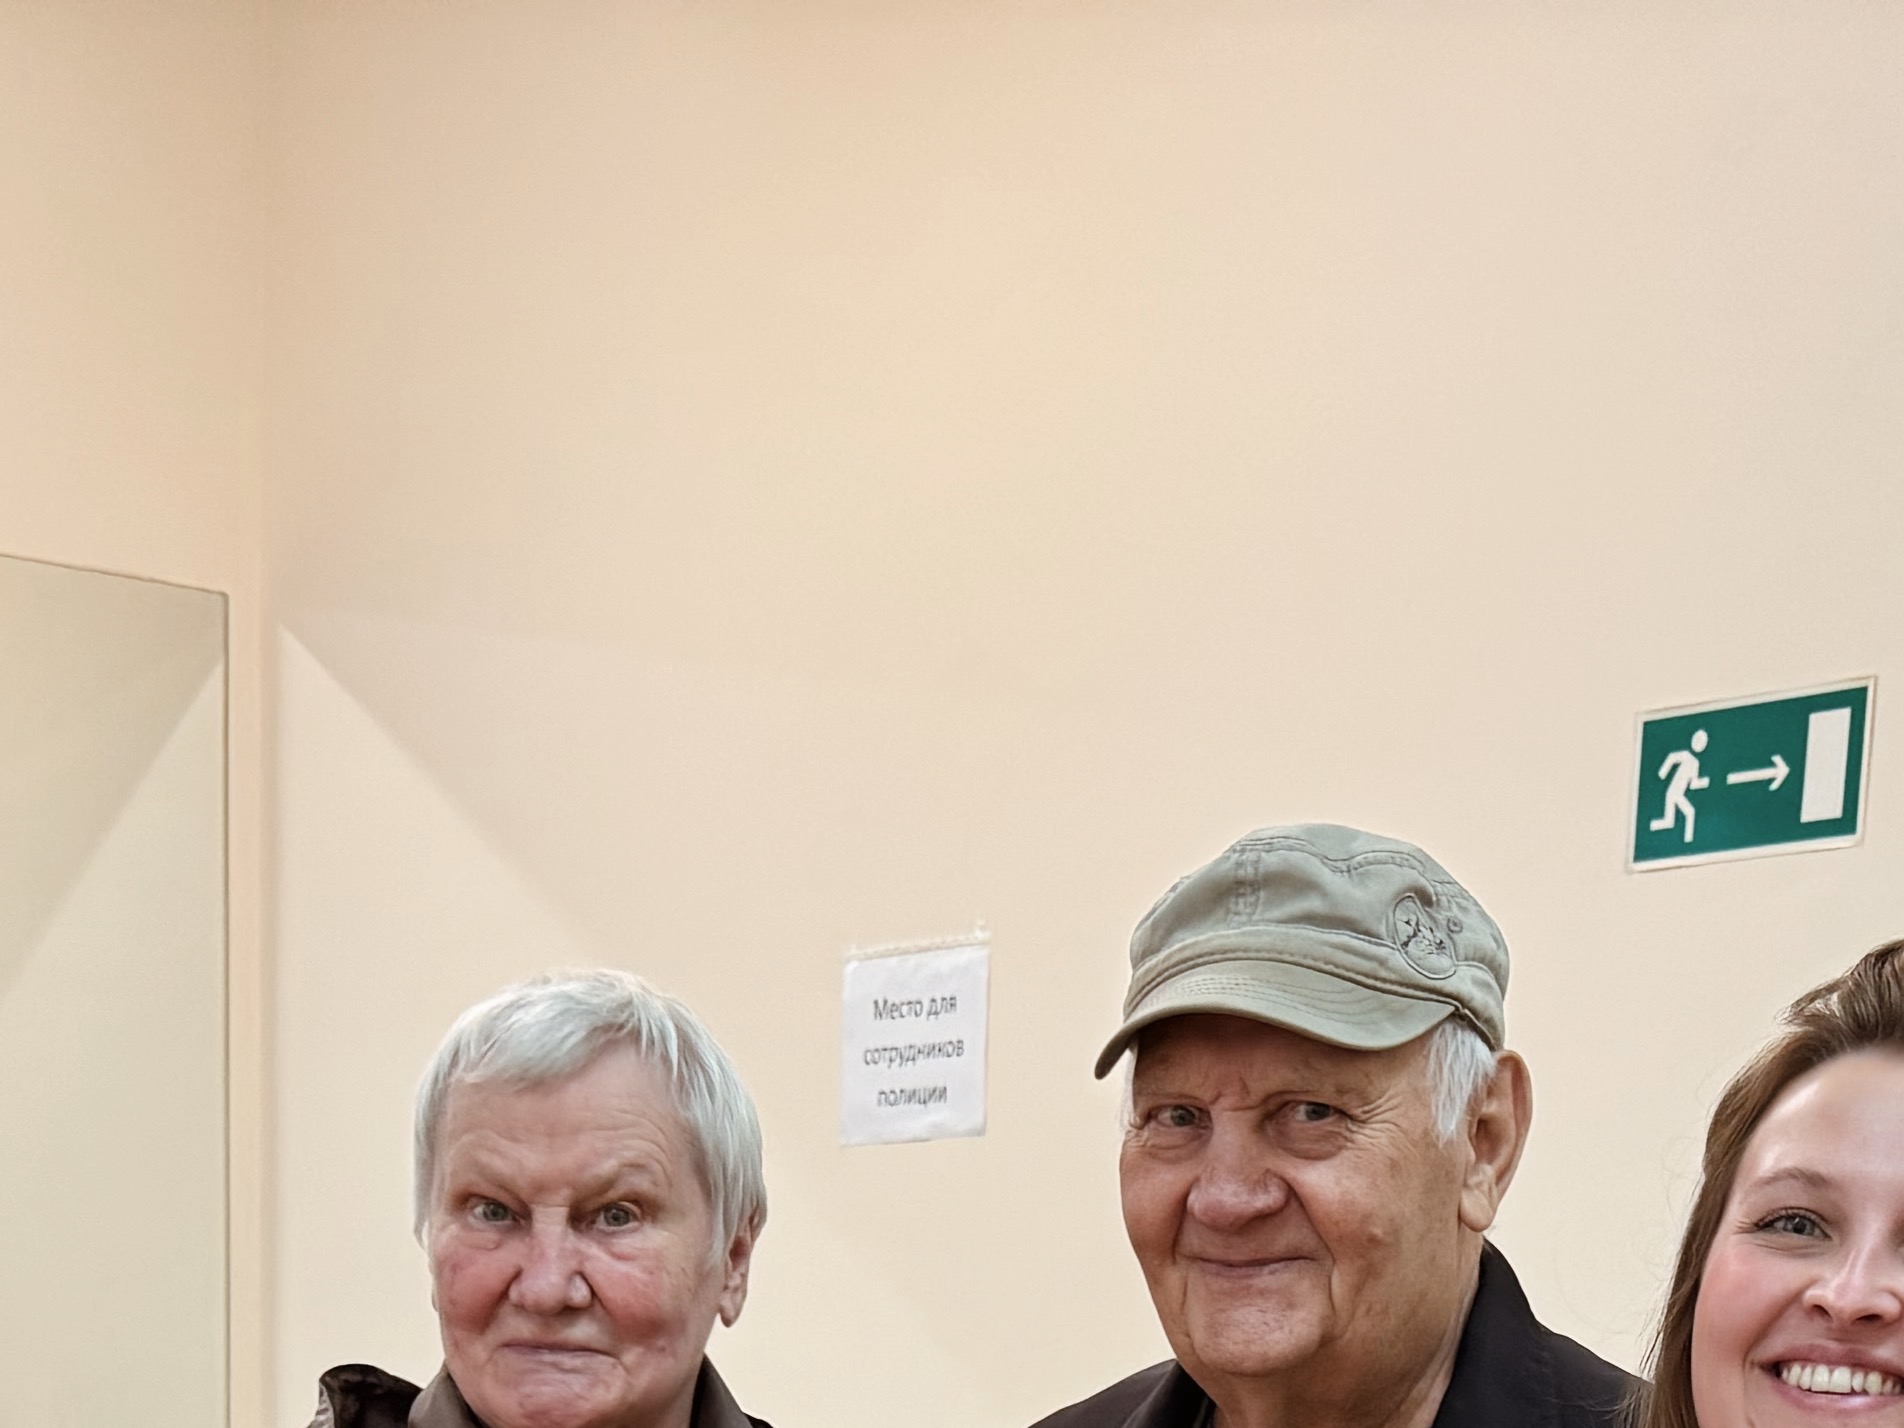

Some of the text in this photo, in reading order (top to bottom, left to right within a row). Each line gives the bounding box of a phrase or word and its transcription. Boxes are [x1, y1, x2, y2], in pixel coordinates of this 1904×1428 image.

[872, 995, 957, 1021] Место для
[863, 1039, 965, 1069] сотрудников
[876, 1085, 948, 1108] полиции
